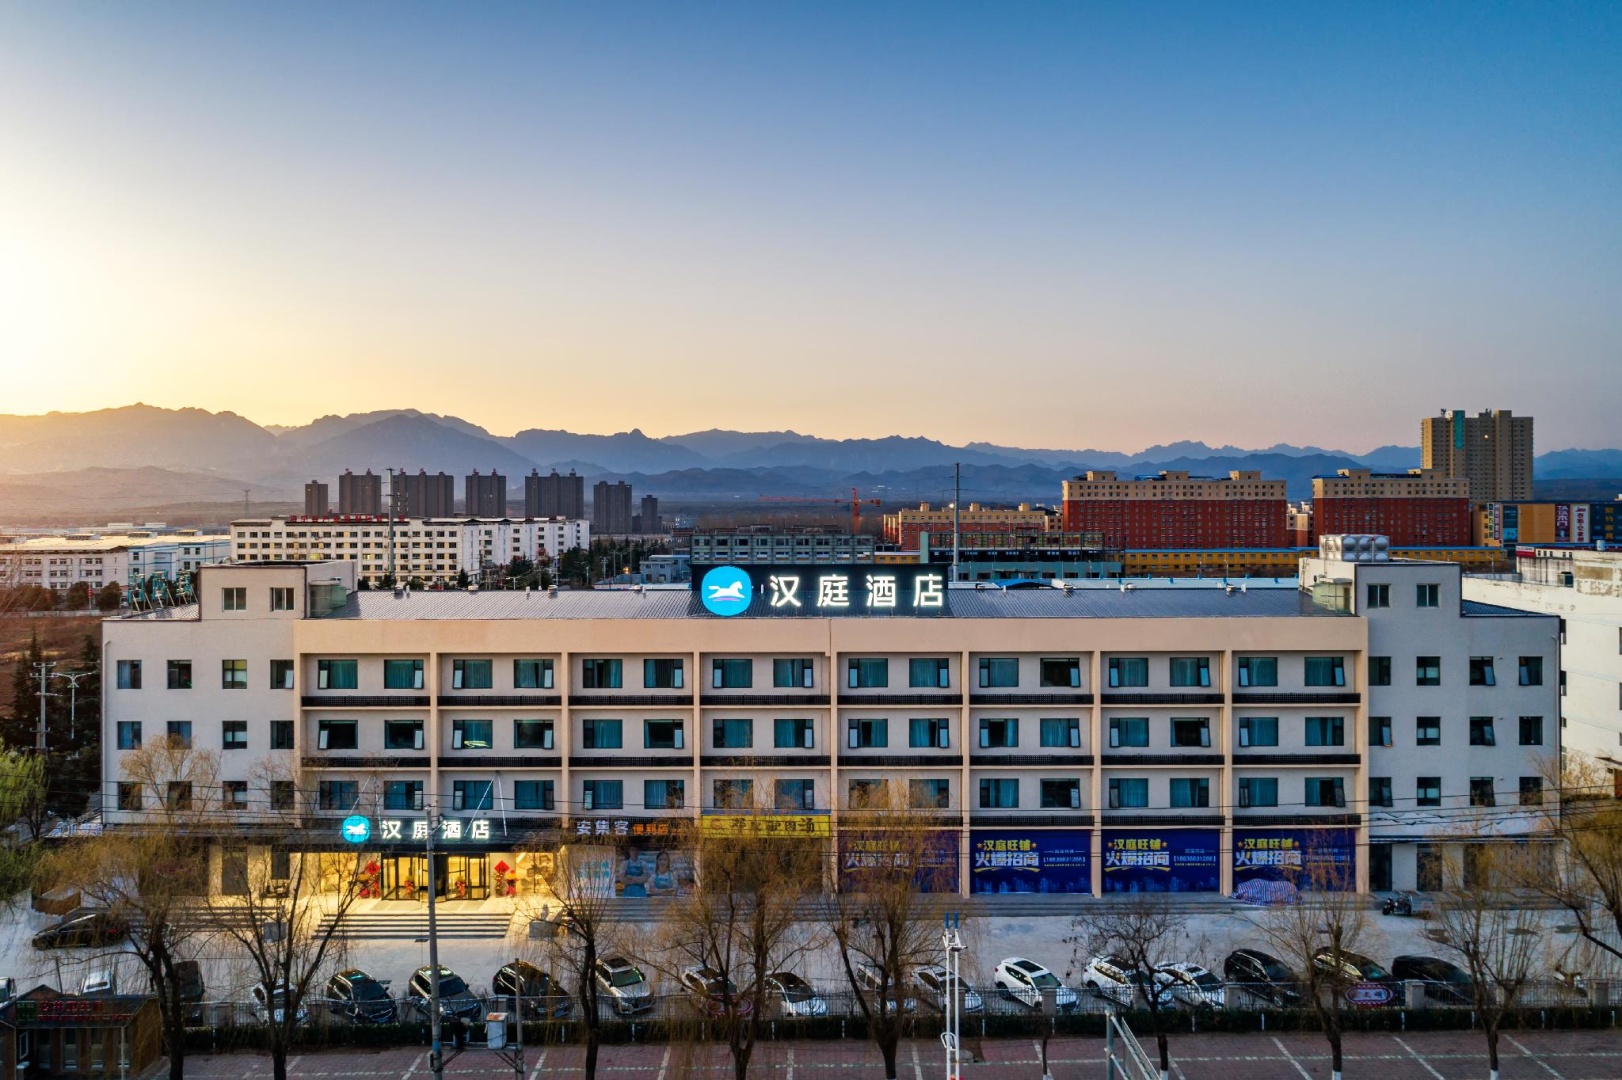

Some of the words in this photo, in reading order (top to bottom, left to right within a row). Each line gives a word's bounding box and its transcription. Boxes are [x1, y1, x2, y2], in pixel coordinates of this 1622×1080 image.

[769, 574, 943, 608] 汉庭酒店
[381, 820, 490, 839] 汉庭酒店
[576, 820, 629, 835] 安集客
[983, 840, 1031, 851] 汉庭旺铺
[1113, 839, 1162, 850] 汉庭旺铺
[975, 852, 1039, 867] 火爆招商
[1105, 851, 1170, 866] 火爆招商
[1235, 850, 1302, 865] 火爆招商
